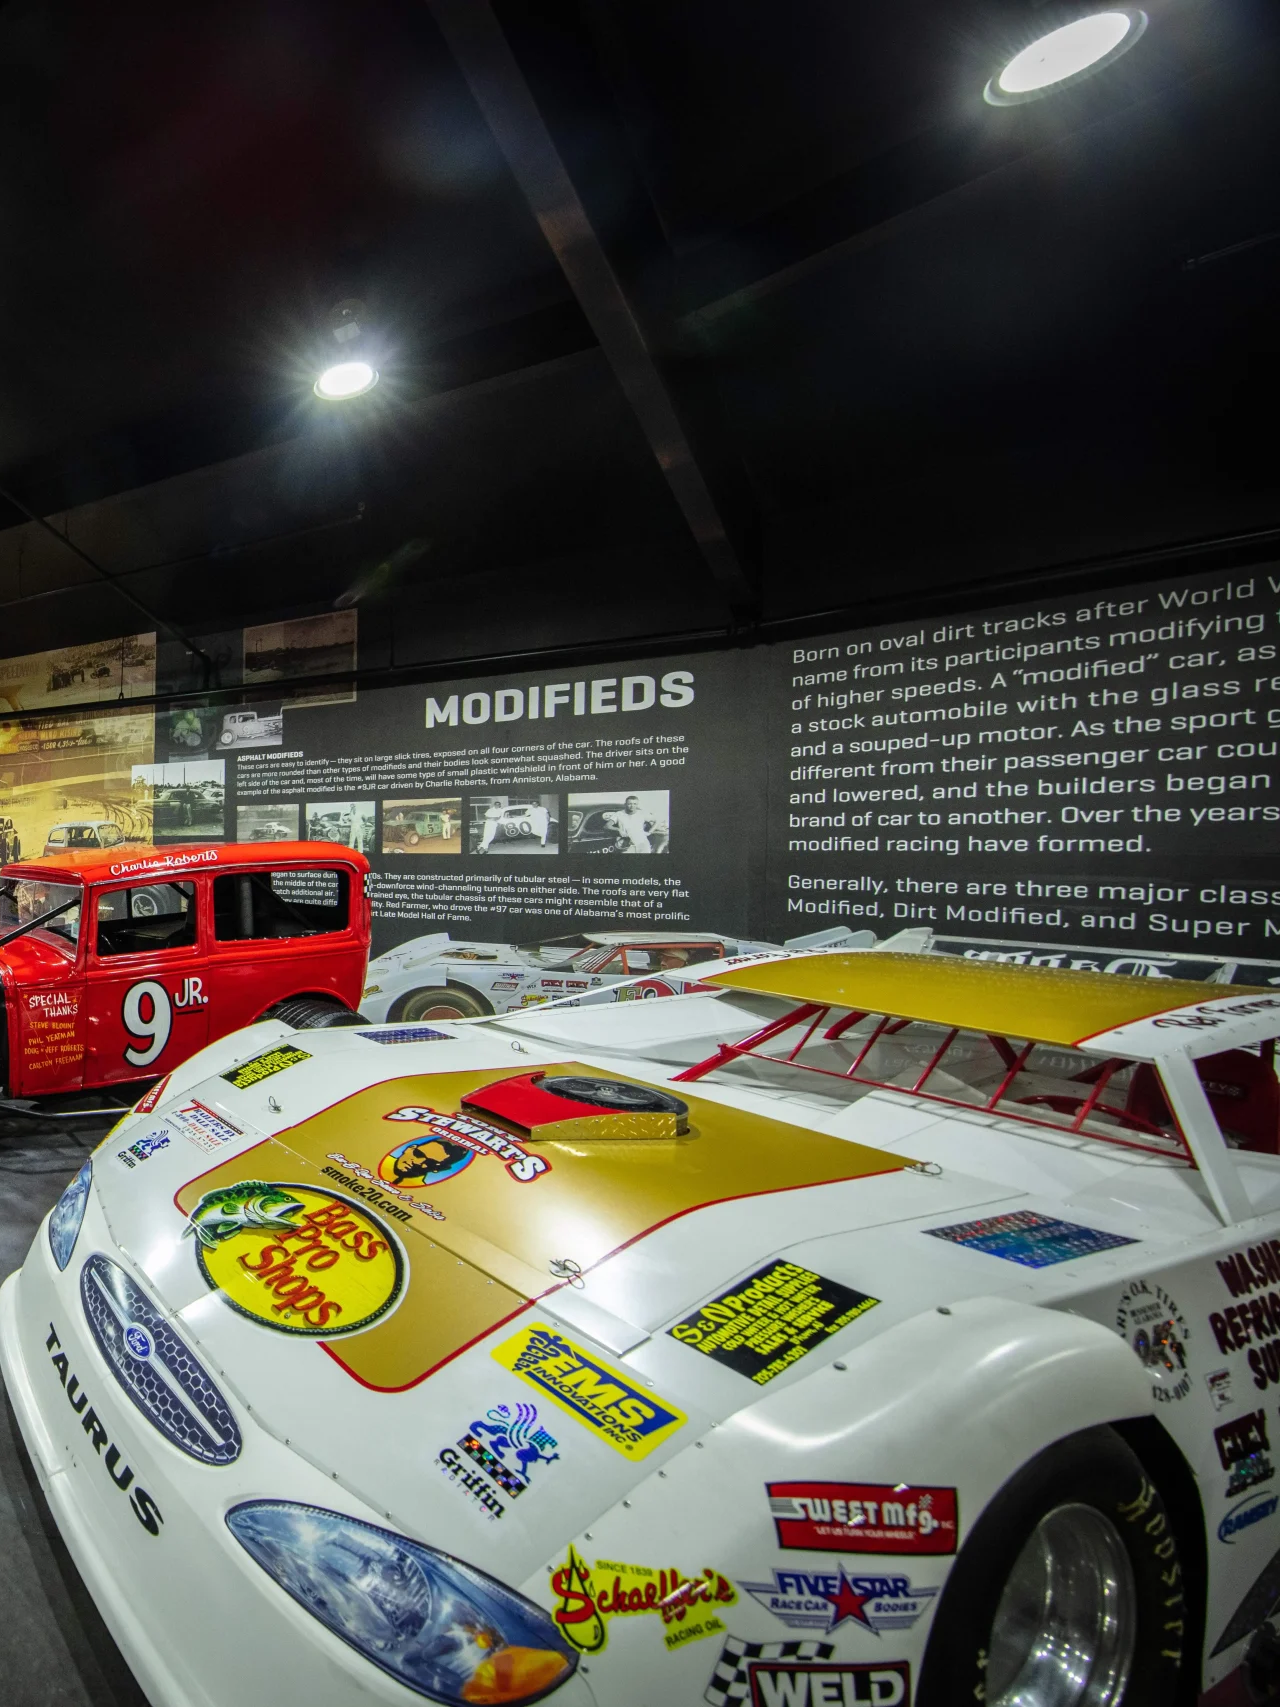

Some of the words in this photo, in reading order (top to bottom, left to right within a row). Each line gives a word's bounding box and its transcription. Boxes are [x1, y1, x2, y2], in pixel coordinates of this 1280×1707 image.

[793, 647, 839, 664] Born
[846, 642, 872, 656] on
[880, 630, 924, 651] oval
[933, 624, 974, 643] dirt
[982, 612, 1066, 635] tracks
[1076, 600, 1148, 622] after
[1158, 579, 1253, 609] World
[792, 670, 847, 687] name
[853, 662, 904, 679] from
[911, 656, 938, 672] its
[945, 636, 1100, 672] participants
[1110, 614, 1264, 646] modifying
[792, 694, 812, 710] of
[817, 690, 885, 710] higher
[891, 676, 982, 702] speeds.
[990, 672, 1007, 689] A
[1012, 653, 1159, 685] “modified”
[1169, 651, 1225, 669] car,
[1238, 645, 1276, 662] as
[424, 671, 695, 728] MODIFIEDS
[791, 723, 802, 734] a
[808, 713, 865, 732] stock
[871, 700, 1008, 727] automobile
[1016, 692, 1077, 713] with
[1088, 688, 1138, 707] the
[1151, 681, 1240, 706] glass
[237, 754, 266, 762] ASPHALT
[266, 751, 304, 760] MODIFIEDS
[304, 758, 330, 766] identify
[394, 752, 411, 760] slick
[433, 748, 466, 759] exposed
[480, 747, 490, 755] all
[492, 746, 509, 754] four
[511, 744, 545, 753] corners
[546, 742, 556, 751] of
[558, 742, 574, 750] the
[595, 739, 613, 747] The
[615, 736, 641, 746] roofs
[643, 736, 654, 744] of
[656, 735, 685, 744] these
[504, 819, 533, 838] 80
[789, 836, 879, 852] modified
[886, 836, 959, 856] racing
[968, 835, 1029, 852] have
[1036, 834, 1151, 852] formed.
[110, 859, 160, 876] Charlie
[165, 849, 218, 867] Roberts
[788, 898, 884, 918] Modified,
[894, 902, 937, 920] Dirt
[946, 905, 1069, 928] Modified,
[1081, 912, 1136, 930] and
[1149, 914, 1250, 938] Super
[29, 992, 71, 1009] SPECIAL
[42, 1003, 79, 1018] THANKS
[29, 1021, 49, 1030] STEVE
[51, 1022, 76, 1030] BLOUNT
[123, 979, 173, 1068] 9
[174, 977, 209, 1009] JR.
[24, 1047, 40, 1055] DOUG
[44, 1045, 58, 1054] JEFF
[60, 1044, 85, 1053] ROBERTS
[28, 1037, 44, 1046] PHIL
[45, 1031, 75, 1043] YEATMAN
[28, 1060, 53, 1070] CARLTON
[55, 1054, 83, 1066] FREEMAN
[432, 1126, 489, 1155] ORIGINAL
[117, 1151, 137, 1169] Griffin
[321, 1165, 413, 1223] smoke20.com
[278, 1221, 341, 1270] Pro
[302, 1200, 389, 1262] Bass
[239, 1245, 343, 1327] Shops
[722, 1263, 805, 1312] Products
[696, 1312, 755, 1355] AUTOMOTIVE
[747, 1294, 784, 1318] DETAIL
[775, 1271, 821, 1297] SUPPLIES
[128, 1330, 148, 1353] Ford
[533, 1367, 643, 1443] INNOVATIONS
[552, 1360, 656, 1427] EMS
[46, 1321, 165, 1537] TAURUS
[603, 1427, 627, 1444] INC
[438, 1446, 506, 1520] Griffin
[770, 1497, 879, 1526] SWEET
[596, 1561, 628, 1574] SINCE
[630, 1566, 654, 1577] 1839
[776, 1572, 839, 1595] FIVE
[851, 1577, 911, 1598] STAR
[770, 1598, 801, 1611] RACE
[804, 1599, 829, 1611] CAR
[874, 1601, 918, 1613] BODIES
[665, 1623, 704, 1647] RACING
[704, 1618, 724, 1632] OIL
[755, 1670, 906, 1707] WELD
